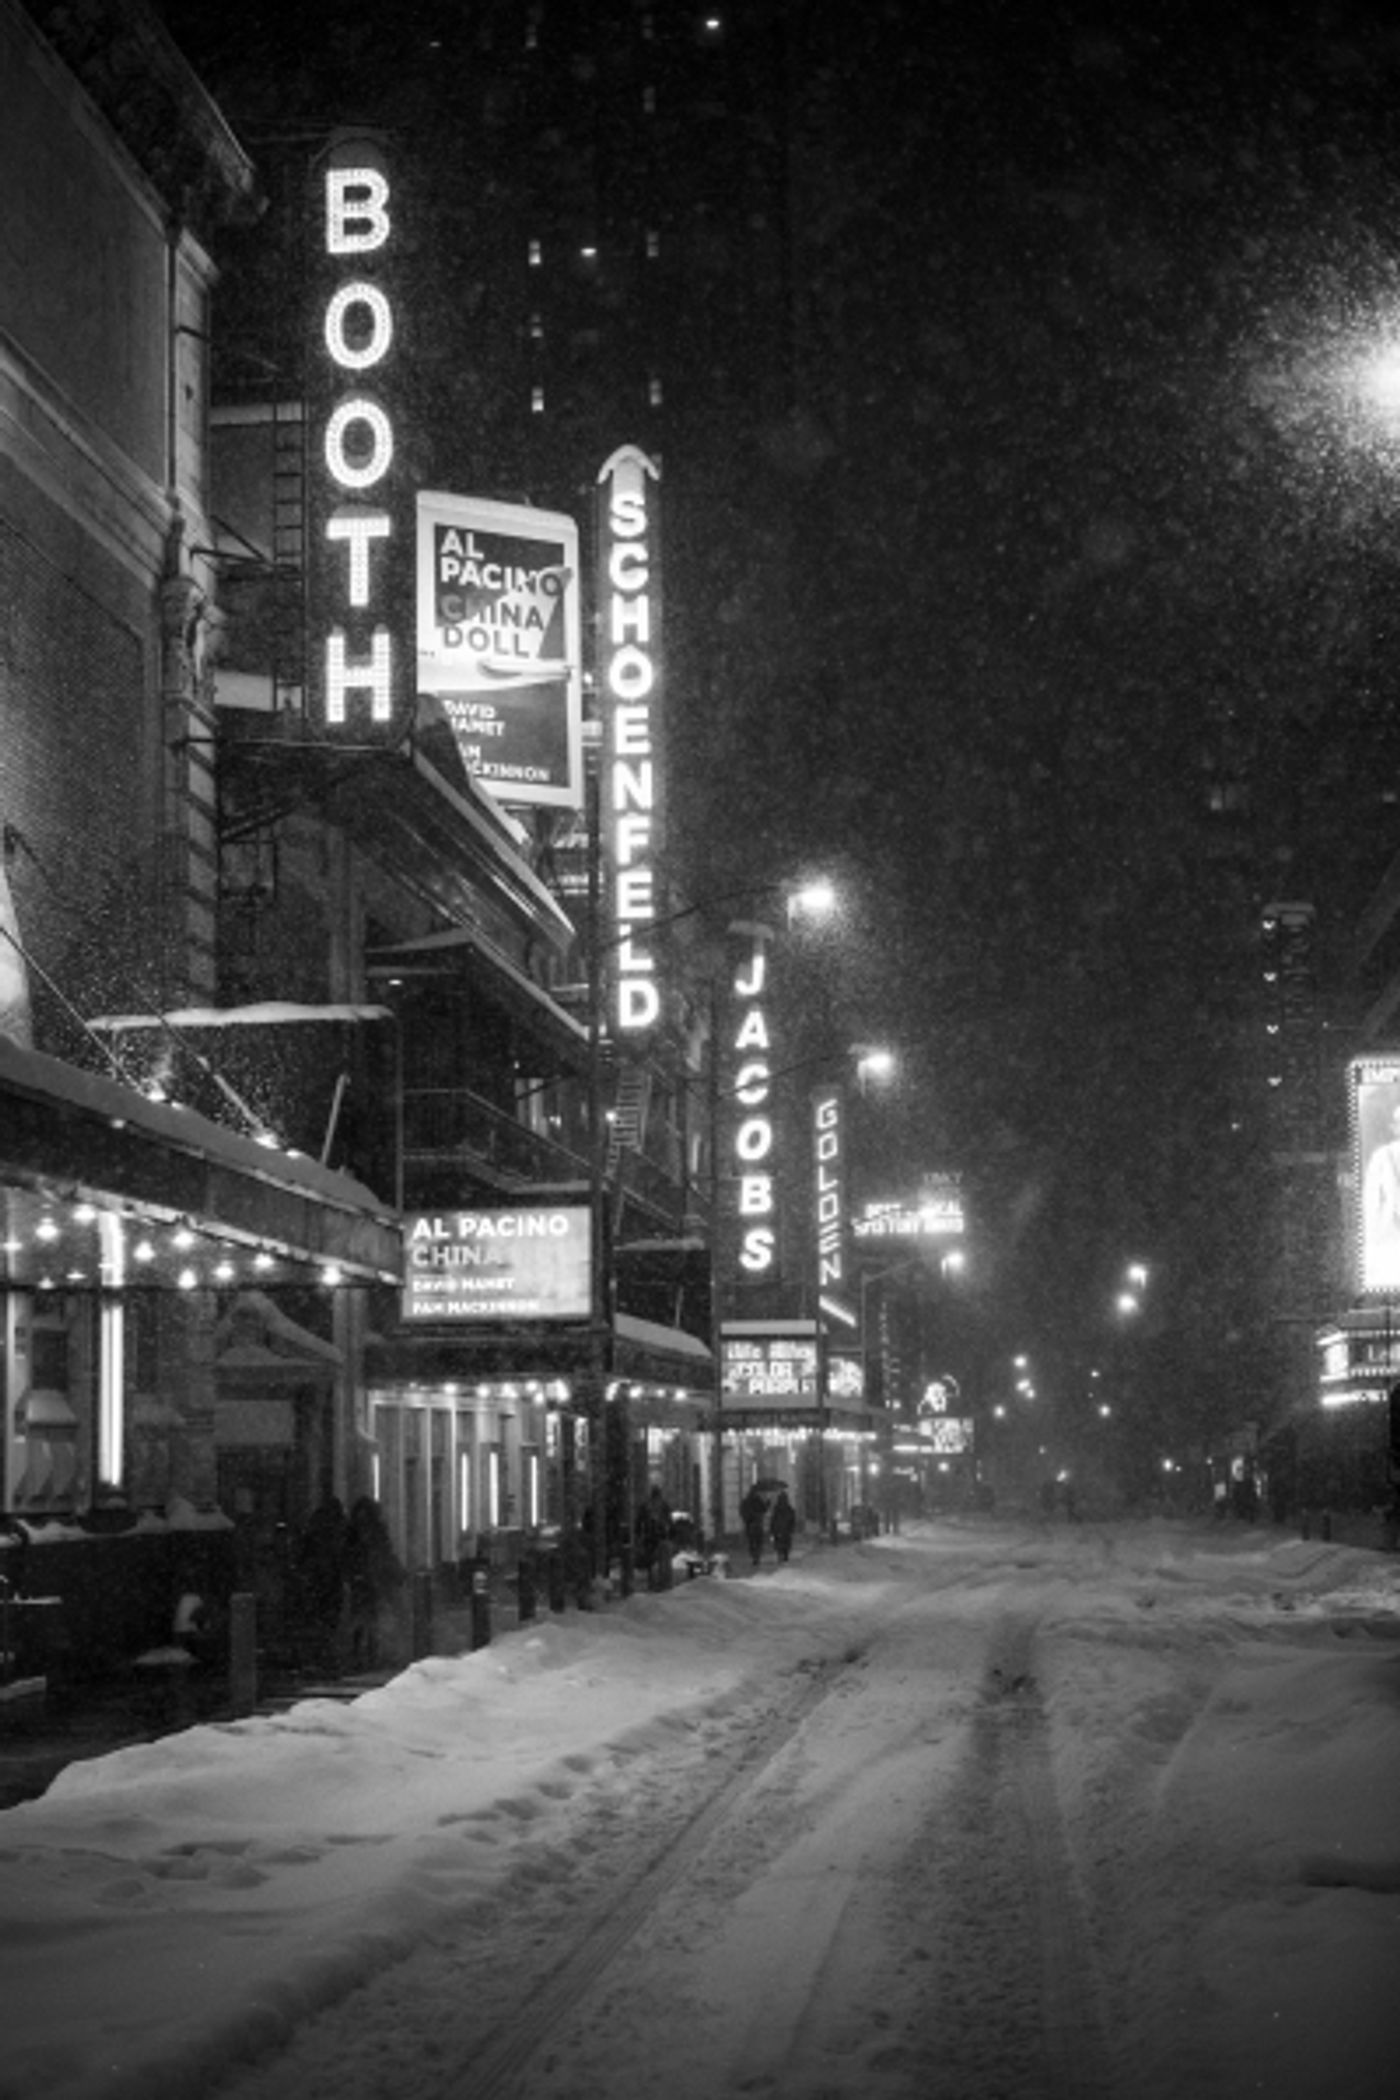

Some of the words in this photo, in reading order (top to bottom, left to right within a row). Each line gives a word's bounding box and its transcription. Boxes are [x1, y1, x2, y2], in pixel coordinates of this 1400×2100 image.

[325, 168, 393, 723] BOOTH
[440, 528, 485, 560] AL
[440, 556, 562, 598] PACINO
[441, 594, 544, 631] CHINA
[443, 625, 530, 658] DOLL
[608, 492, 659, 1029] SCHOENFELD
[734, 954, 775, 1271] JACOBS
[816, 1098, 841, 1286] GOLDEN
[412, 1217, 452, 1240] AL
[458, 1213, 570, 1238] PACINO
[412, 1245, 502, 1268] CHINA
